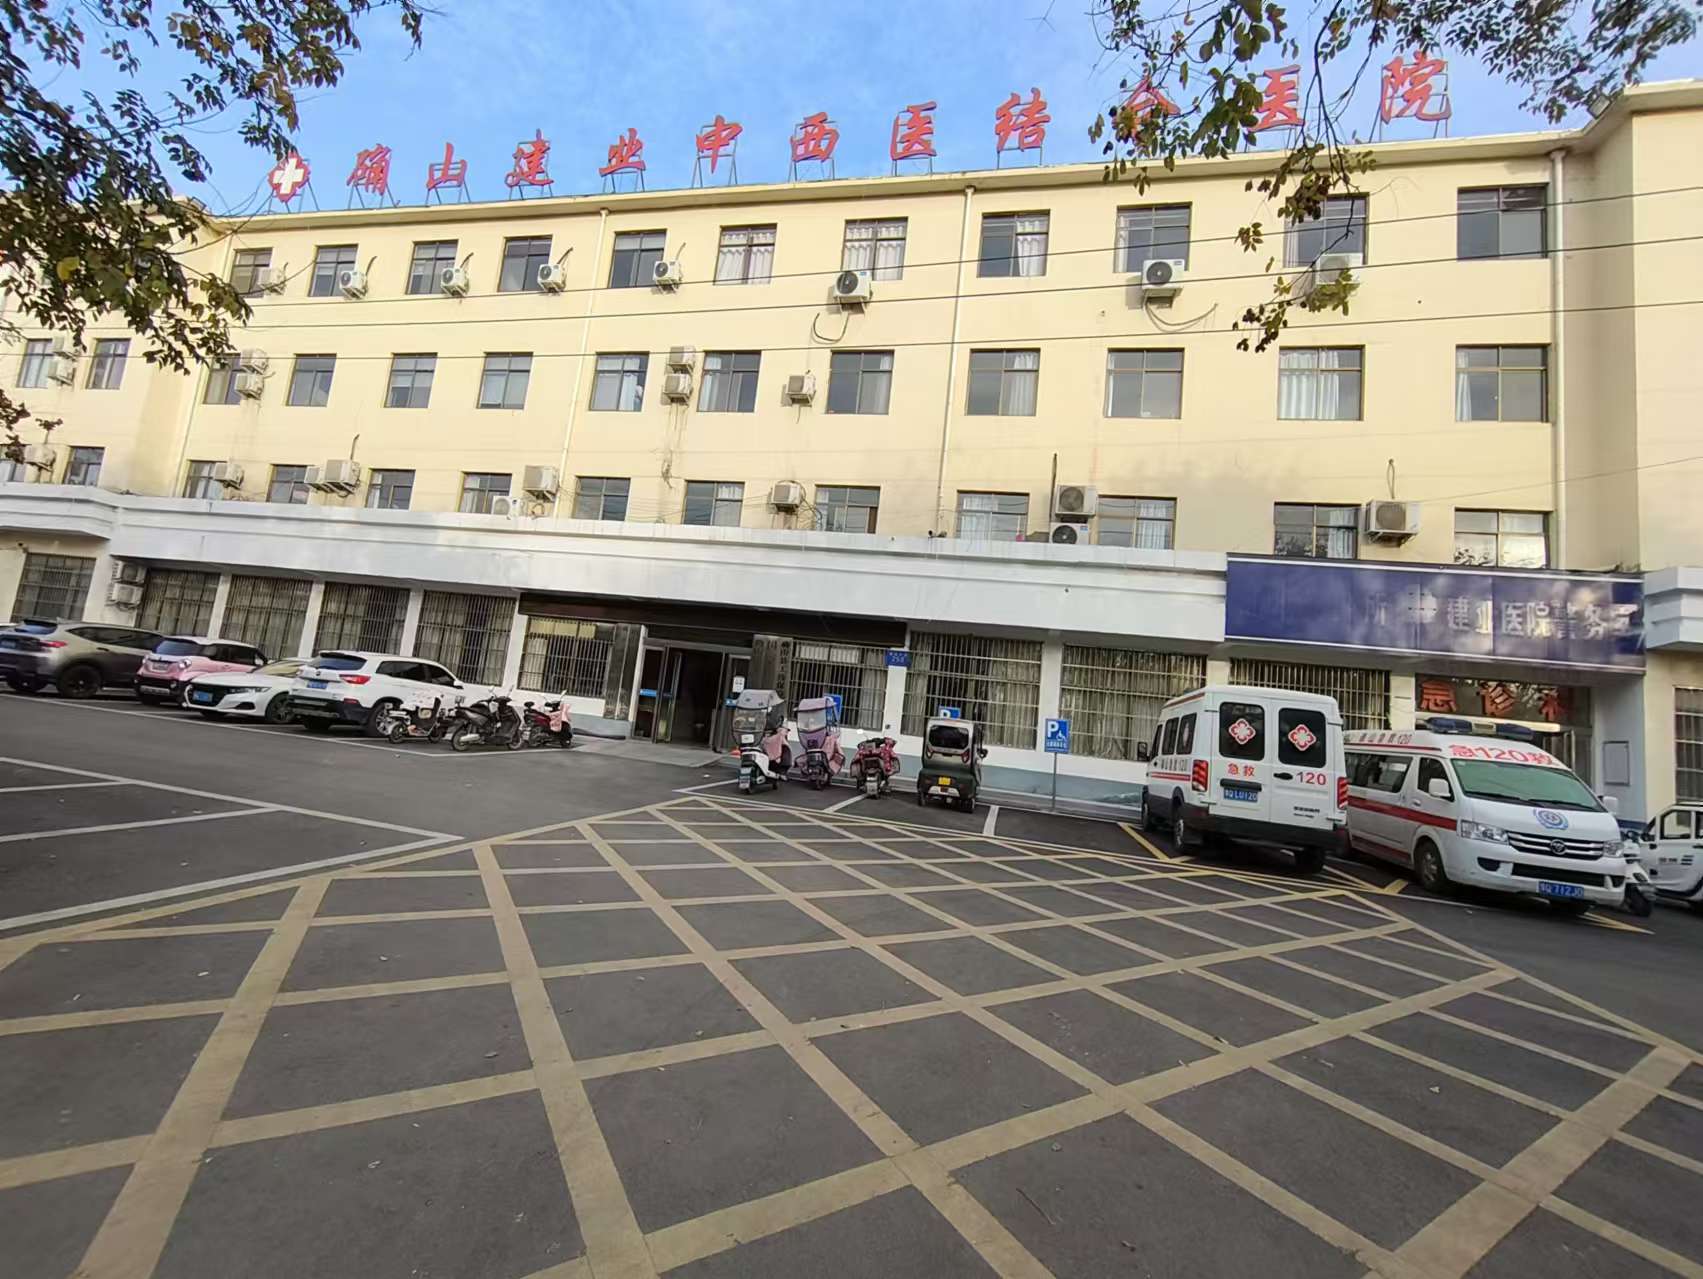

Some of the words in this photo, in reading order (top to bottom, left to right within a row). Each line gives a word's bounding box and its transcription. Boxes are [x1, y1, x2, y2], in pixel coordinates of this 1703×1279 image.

[1047, 721, 1059, 738] P
[1228, 763, 1254, 777] 急救
[1296, 771, 1326, 786] 120
